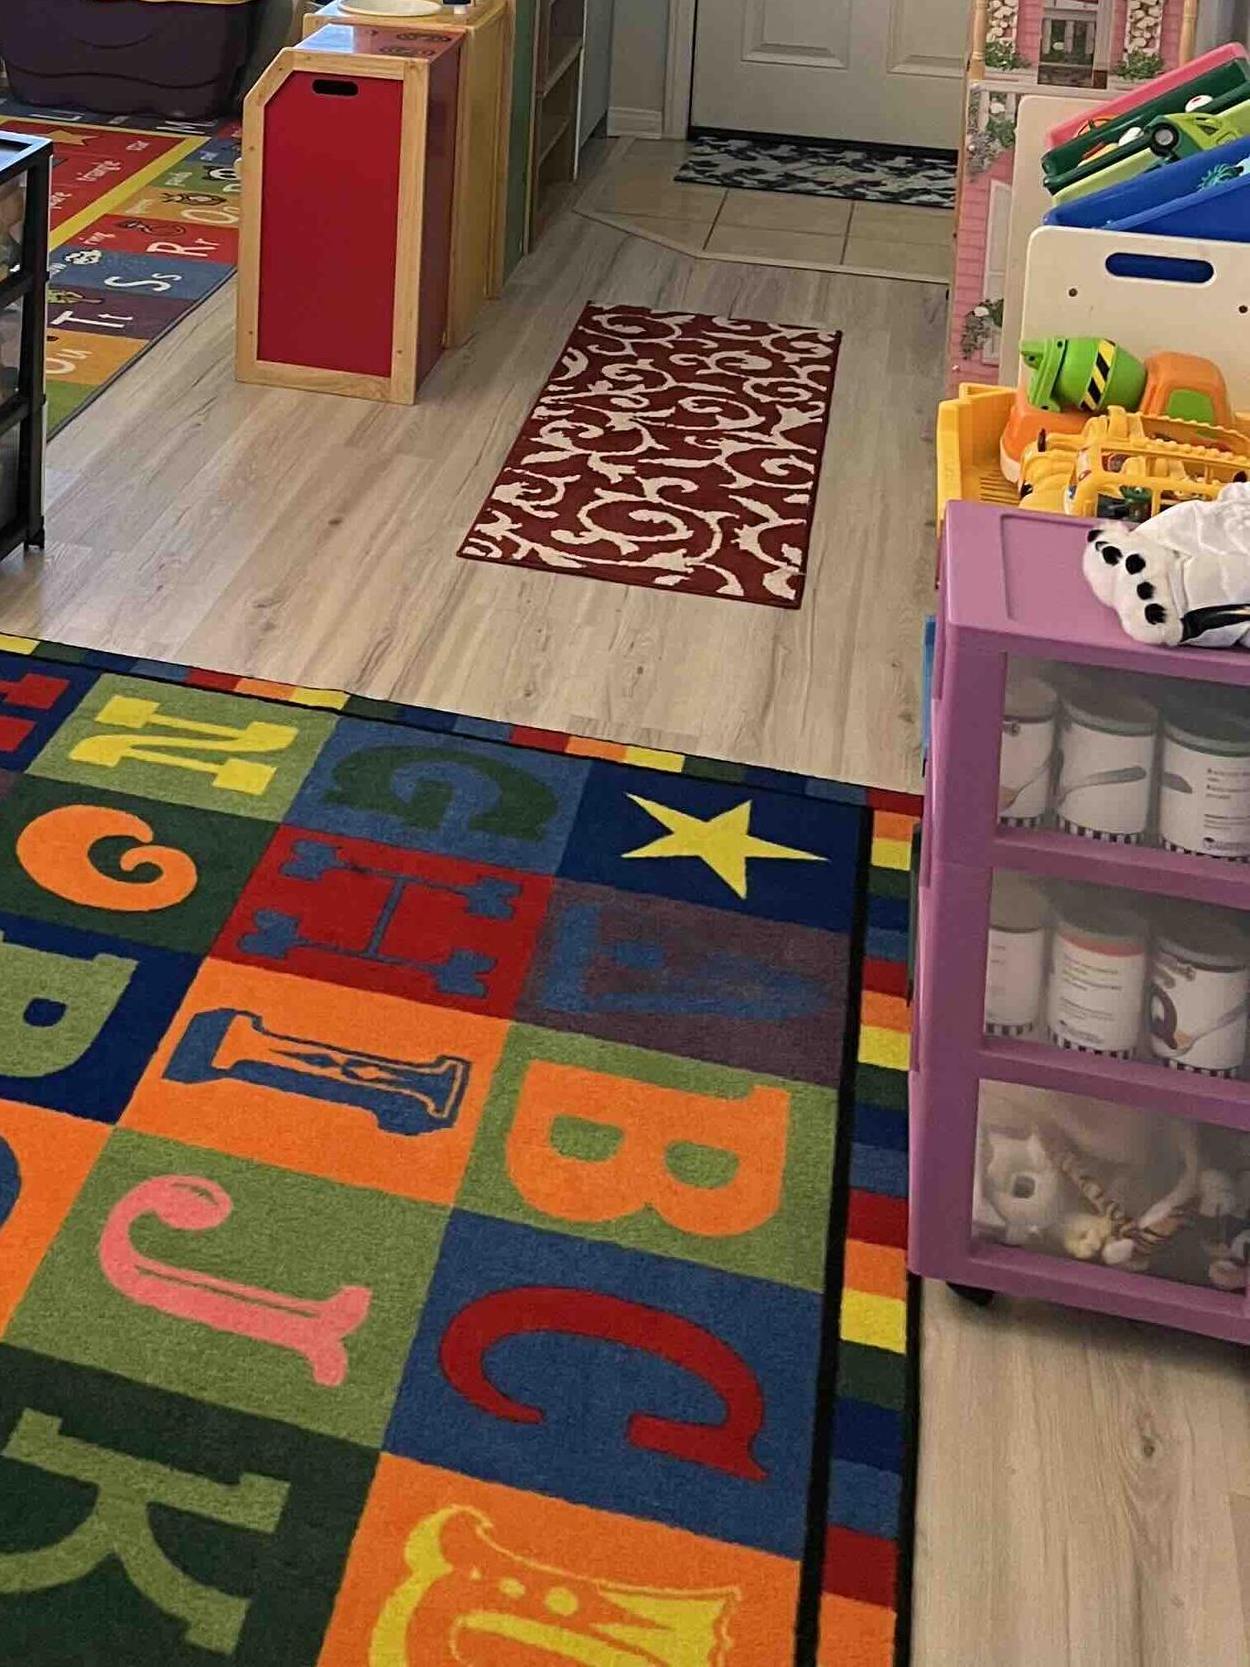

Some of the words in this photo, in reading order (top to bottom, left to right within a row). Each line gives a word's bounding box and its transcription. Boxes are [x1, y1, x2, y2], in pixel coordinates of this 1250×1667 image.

[50, 310, 134, 329] Tt
[103, 272, 183, 292] Ss
[68, 695, 298, 794] N
[320, 743, 558, 842] G
[240, 838, 523, 998] H
[536, 899, 830, 1021] A
[164, 1008, 471, 1136] I
[506, 1059, 790, 1237] B
[98, 1174, 372, 1387] J
[440, 1284, 768, 1480] C
